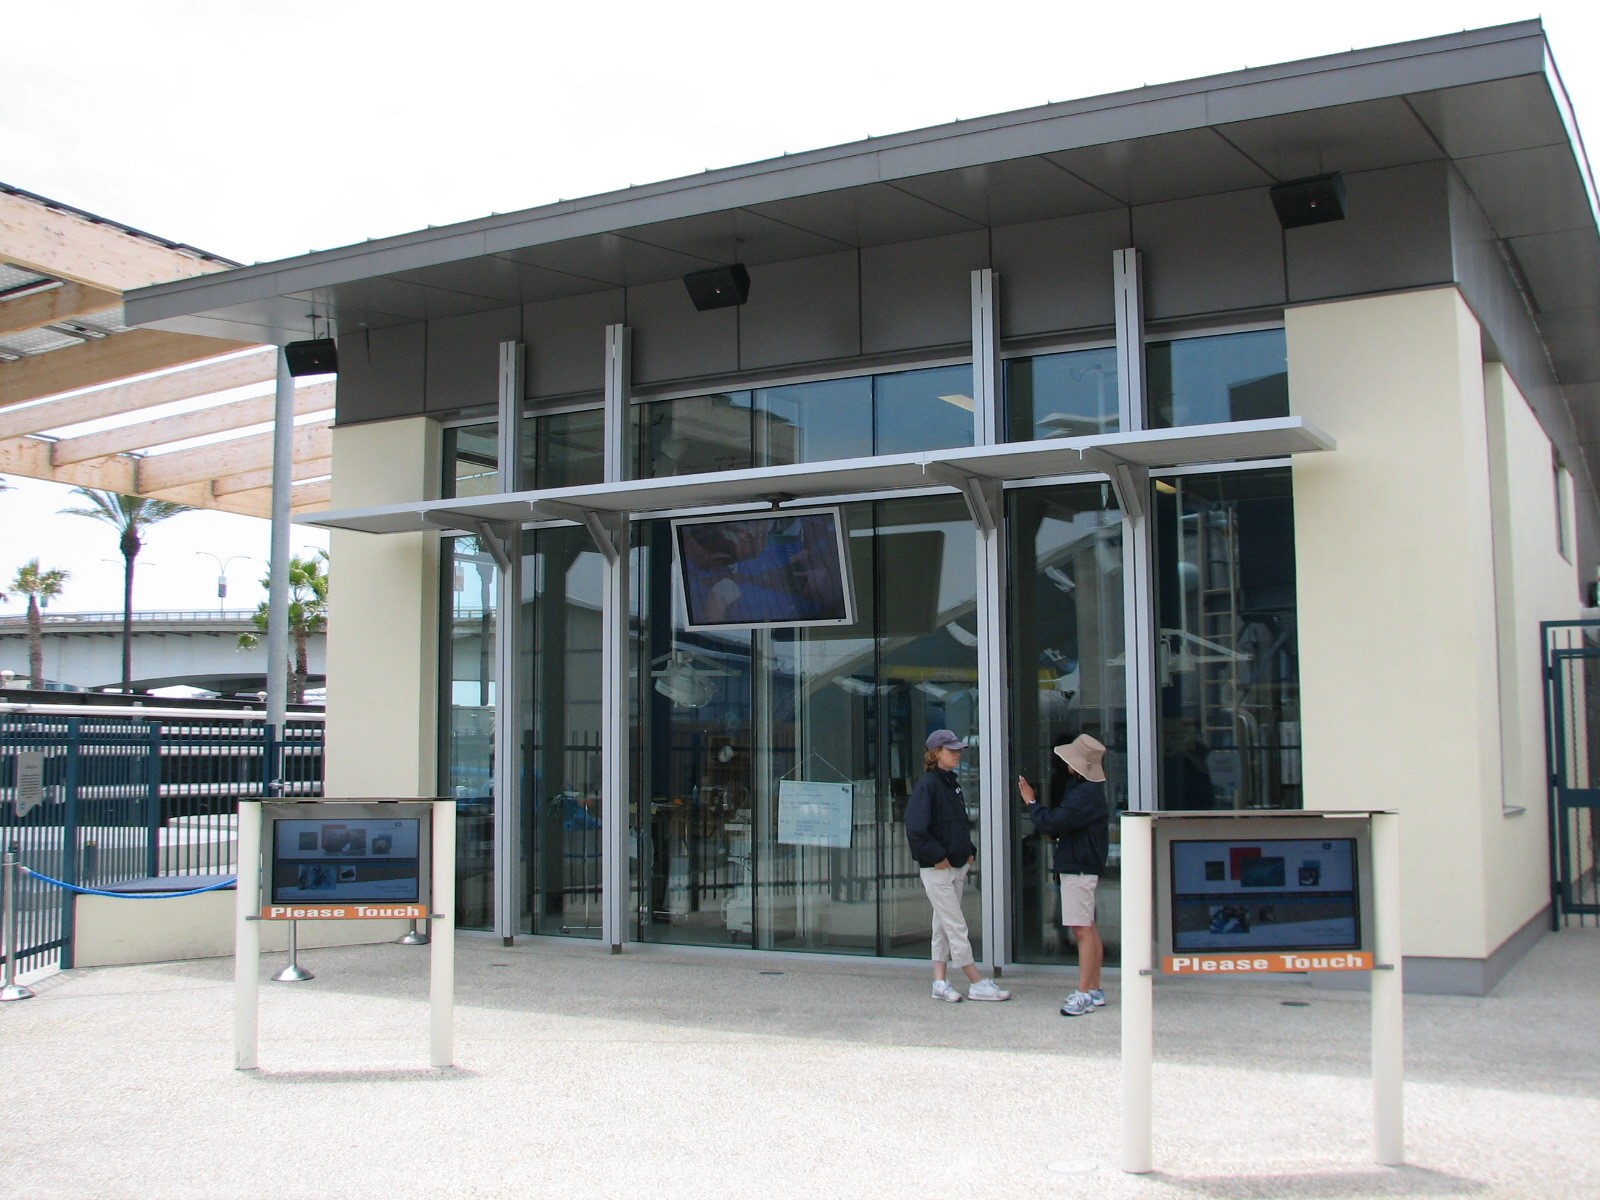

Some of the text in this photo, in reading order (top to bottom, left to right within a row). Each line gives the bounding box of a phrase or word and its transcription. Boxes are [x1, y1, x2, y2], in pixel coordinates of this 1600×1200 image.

[270, 906, 420, 918] Please Touch
[1172, 954, 1363, 972] Please Touch
